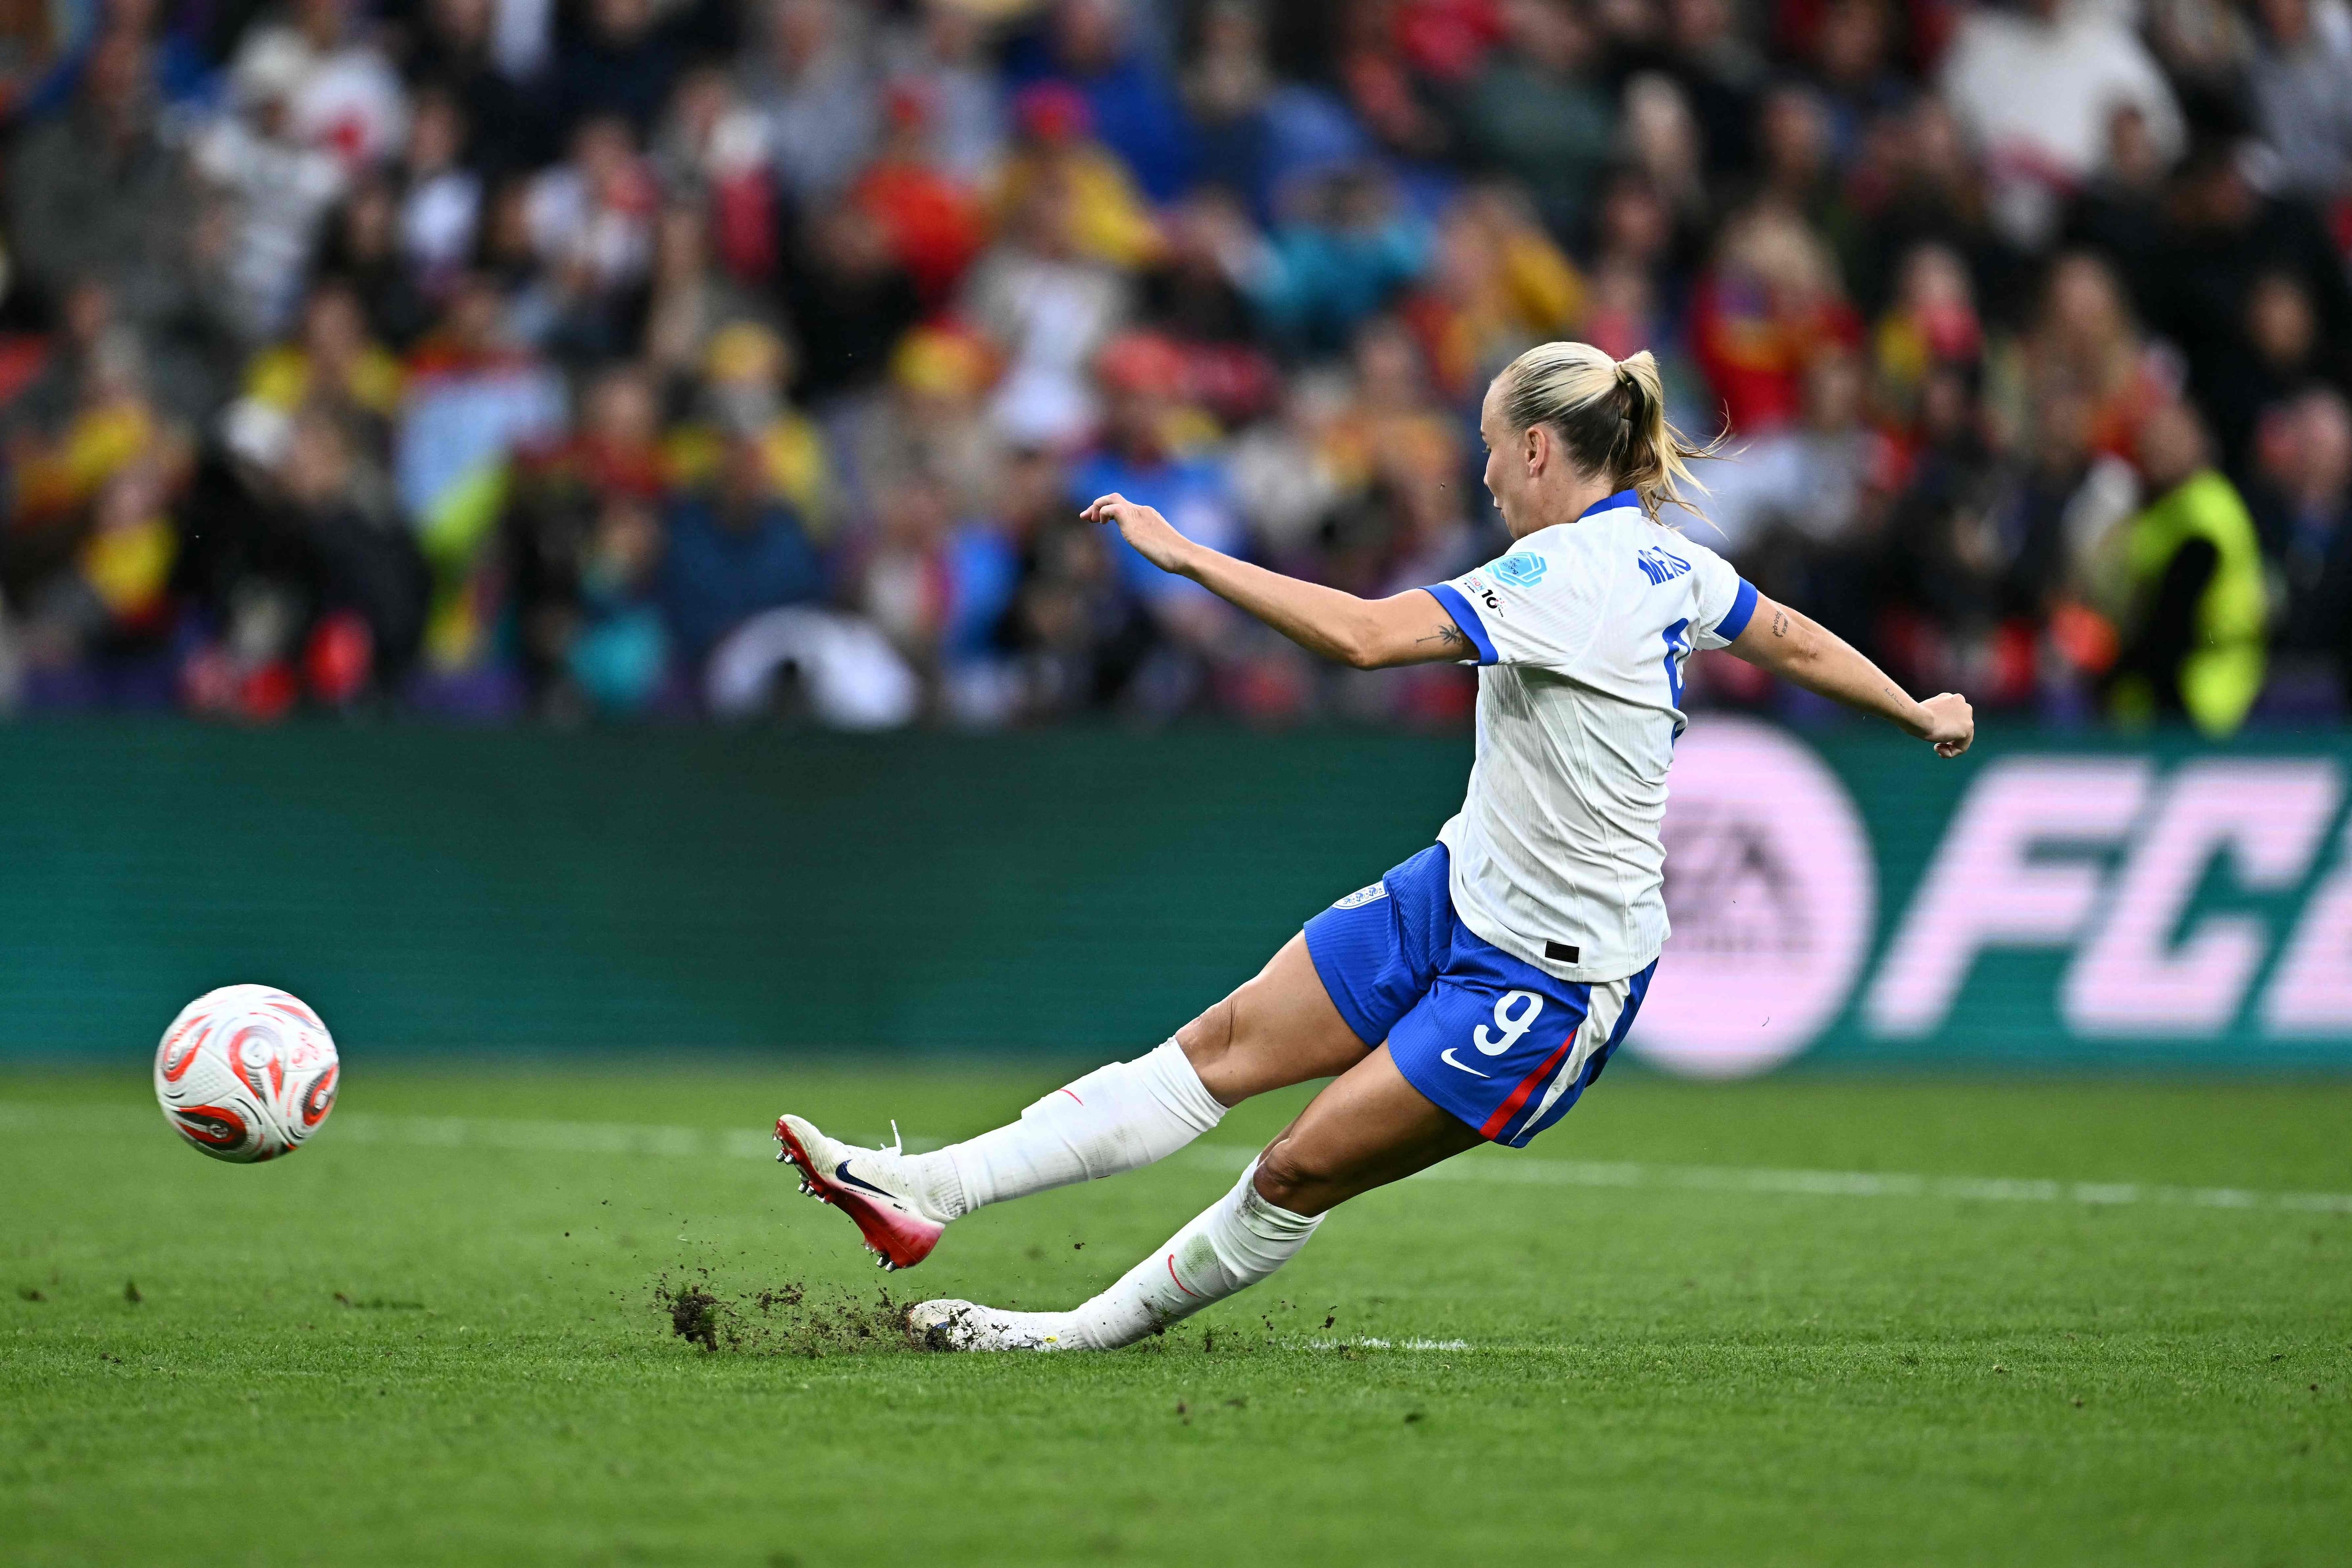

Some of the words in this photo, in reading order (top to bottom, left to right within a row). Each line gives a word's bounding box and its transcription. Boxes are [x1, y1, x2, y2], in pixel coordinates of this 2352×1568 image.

[1481, 589, 1499, 609] 10
[1863, 757, 2352, 1037] FC
[1473, 990, 1544, 1057] 9
